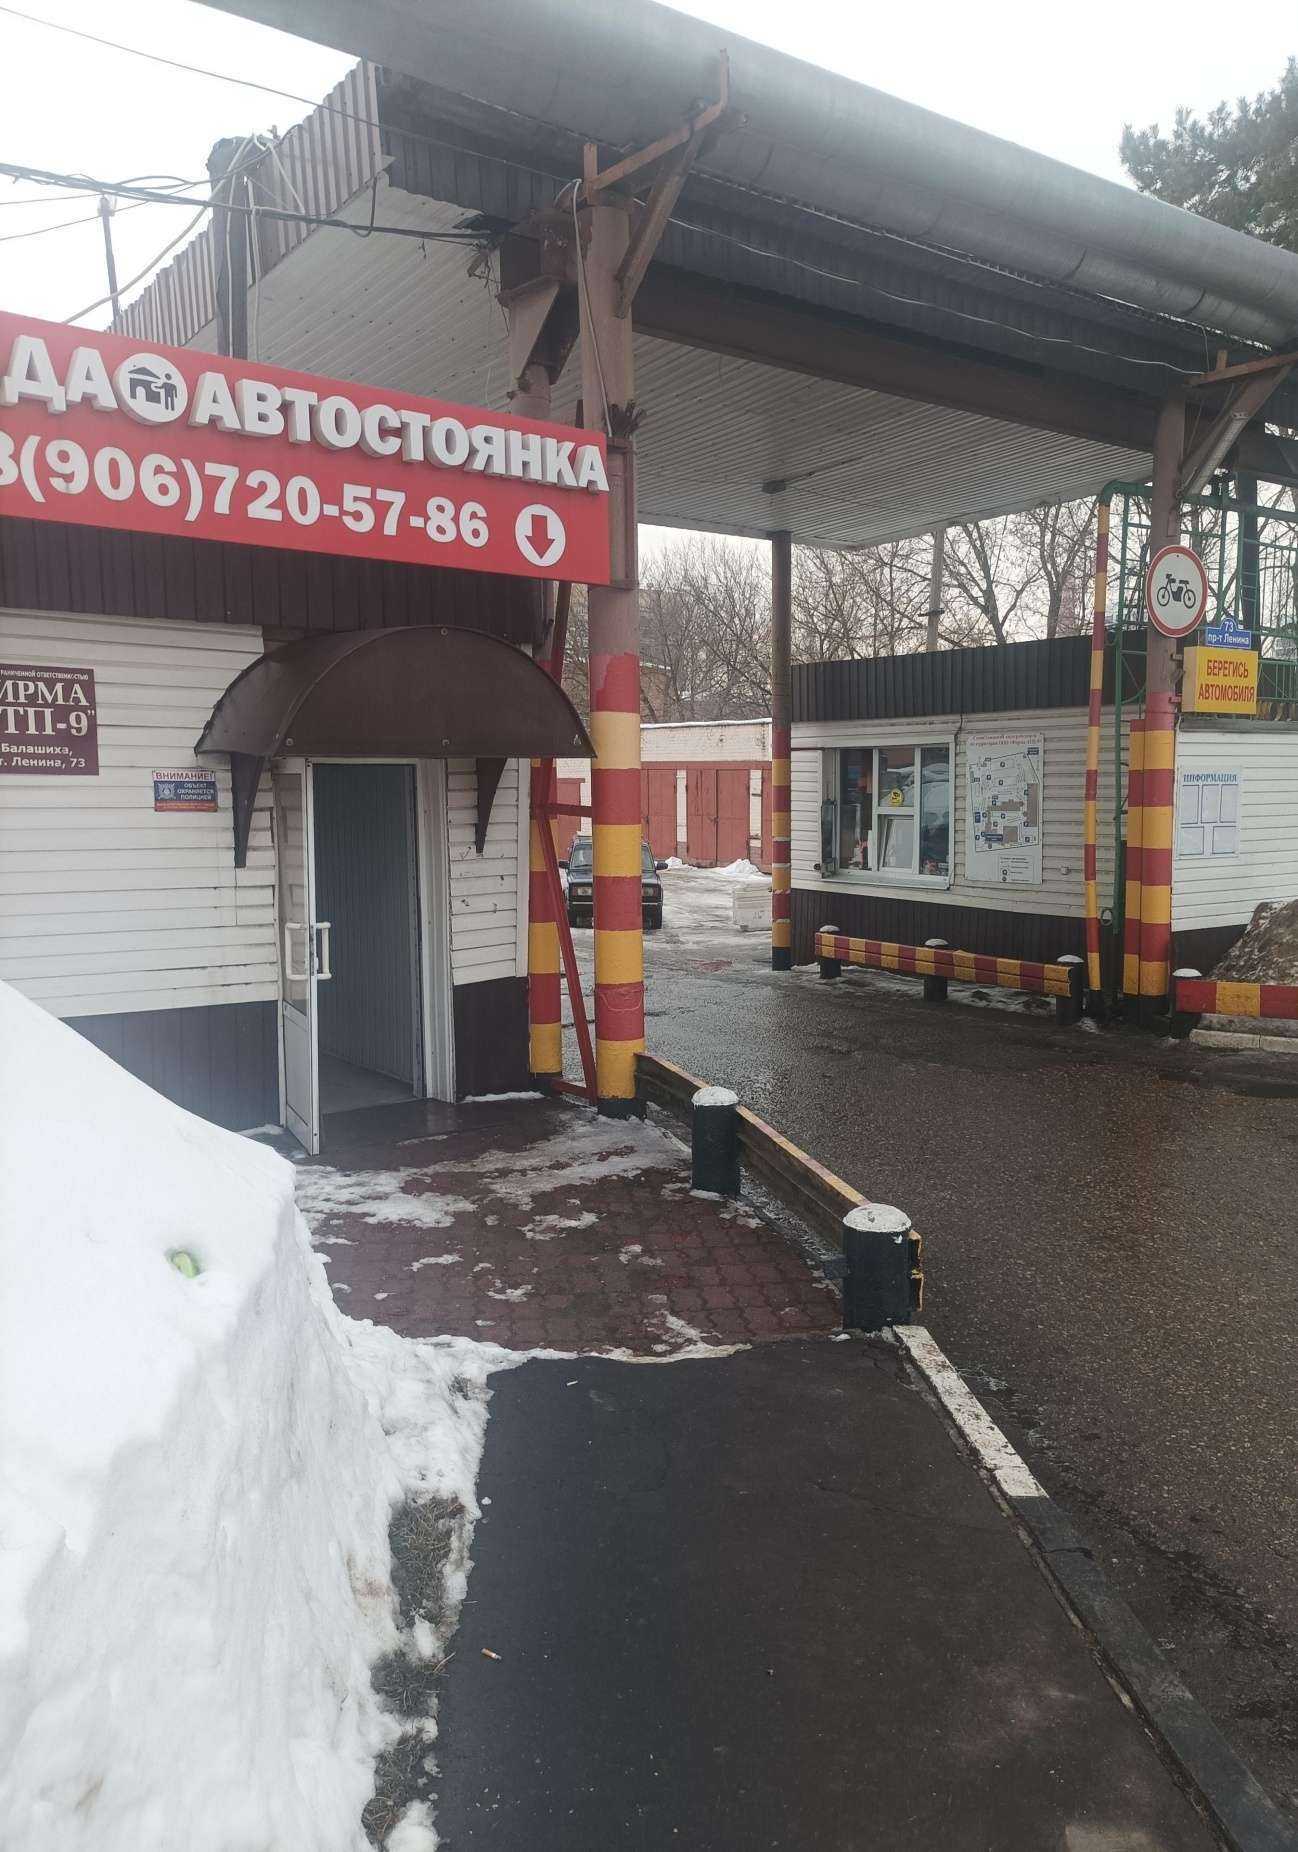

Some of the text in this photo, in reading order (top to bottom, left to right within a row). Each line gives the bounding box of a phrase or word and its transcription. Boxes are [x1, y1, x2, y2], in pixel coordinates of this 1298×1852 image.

[2, 333, 118, 413] ДА
[188, 370, 610, 494] АВТОСТОЯНКА
[1224, 621, 1234, 633] 73
[1207, 633, 1250, 645] пр-т Ленина
[1206, 659, 1249, 679] БЕРЕГИСЬ
[1198, 683, 1255, 702] АВТОМОБИЛЯ
[1, 743, 73, 757] Балашиха,
[12, 756, 66, 769] Ленина,
[70, 758, 87, 768] 73
[1183, 773, 1238, 783] ИНФОРМАЦИЯ
